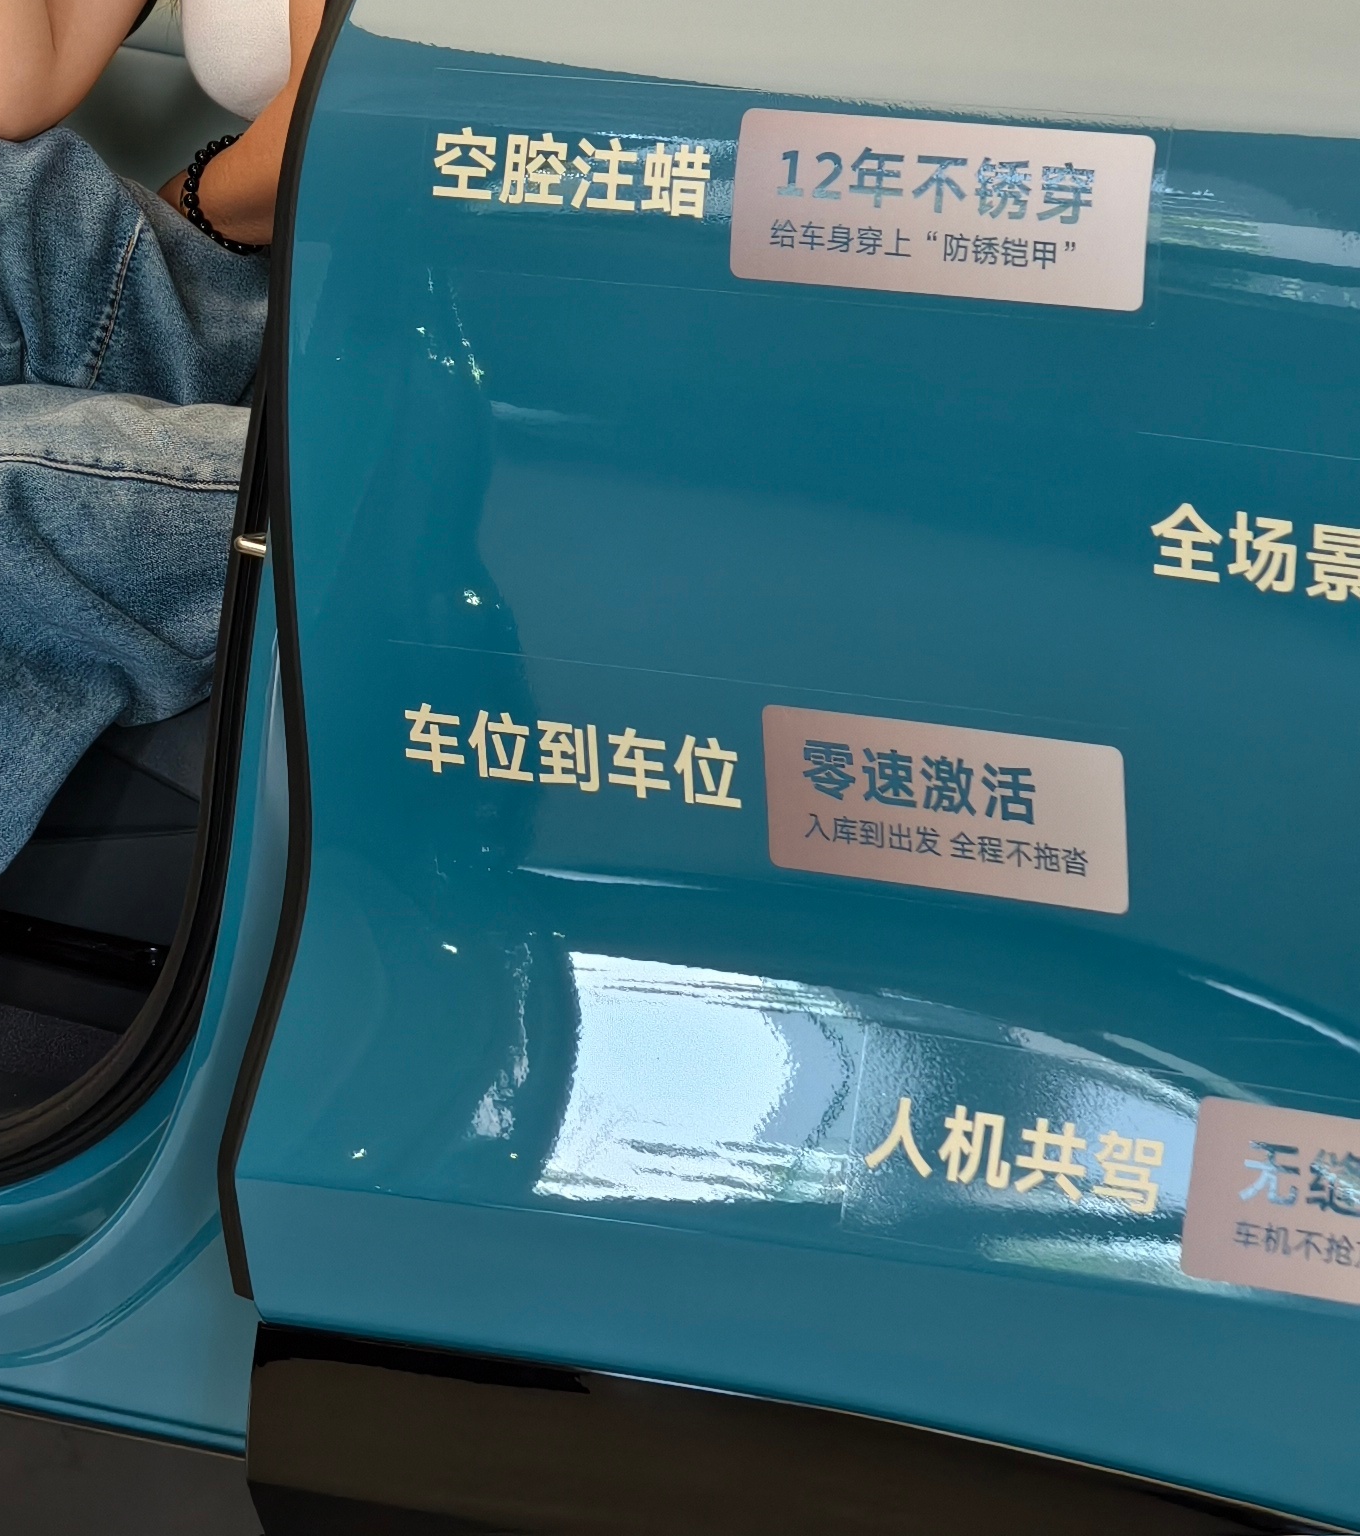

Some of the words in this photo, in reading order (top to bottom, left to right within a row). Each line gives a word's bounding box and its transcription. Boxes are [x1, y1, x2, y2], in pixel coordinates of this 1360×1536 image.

[431, 126, 712, 220] 空腔注蜡
[775, 145, 1097, 226] 12年不锈穿
[1150, 502, 1360, 602] 全场景
[403, 701, 743, 810] 车位到车位
[801, 738, 1037, 826] 零速激活
[804, 811, 943, 858] 入库到出发
[947, 830, 1090, 878] 全程不拖沓
[863, 1095, 1165, 1215] 人机共驾
[1232, 1220, 1360, 1269] 车机不抢
